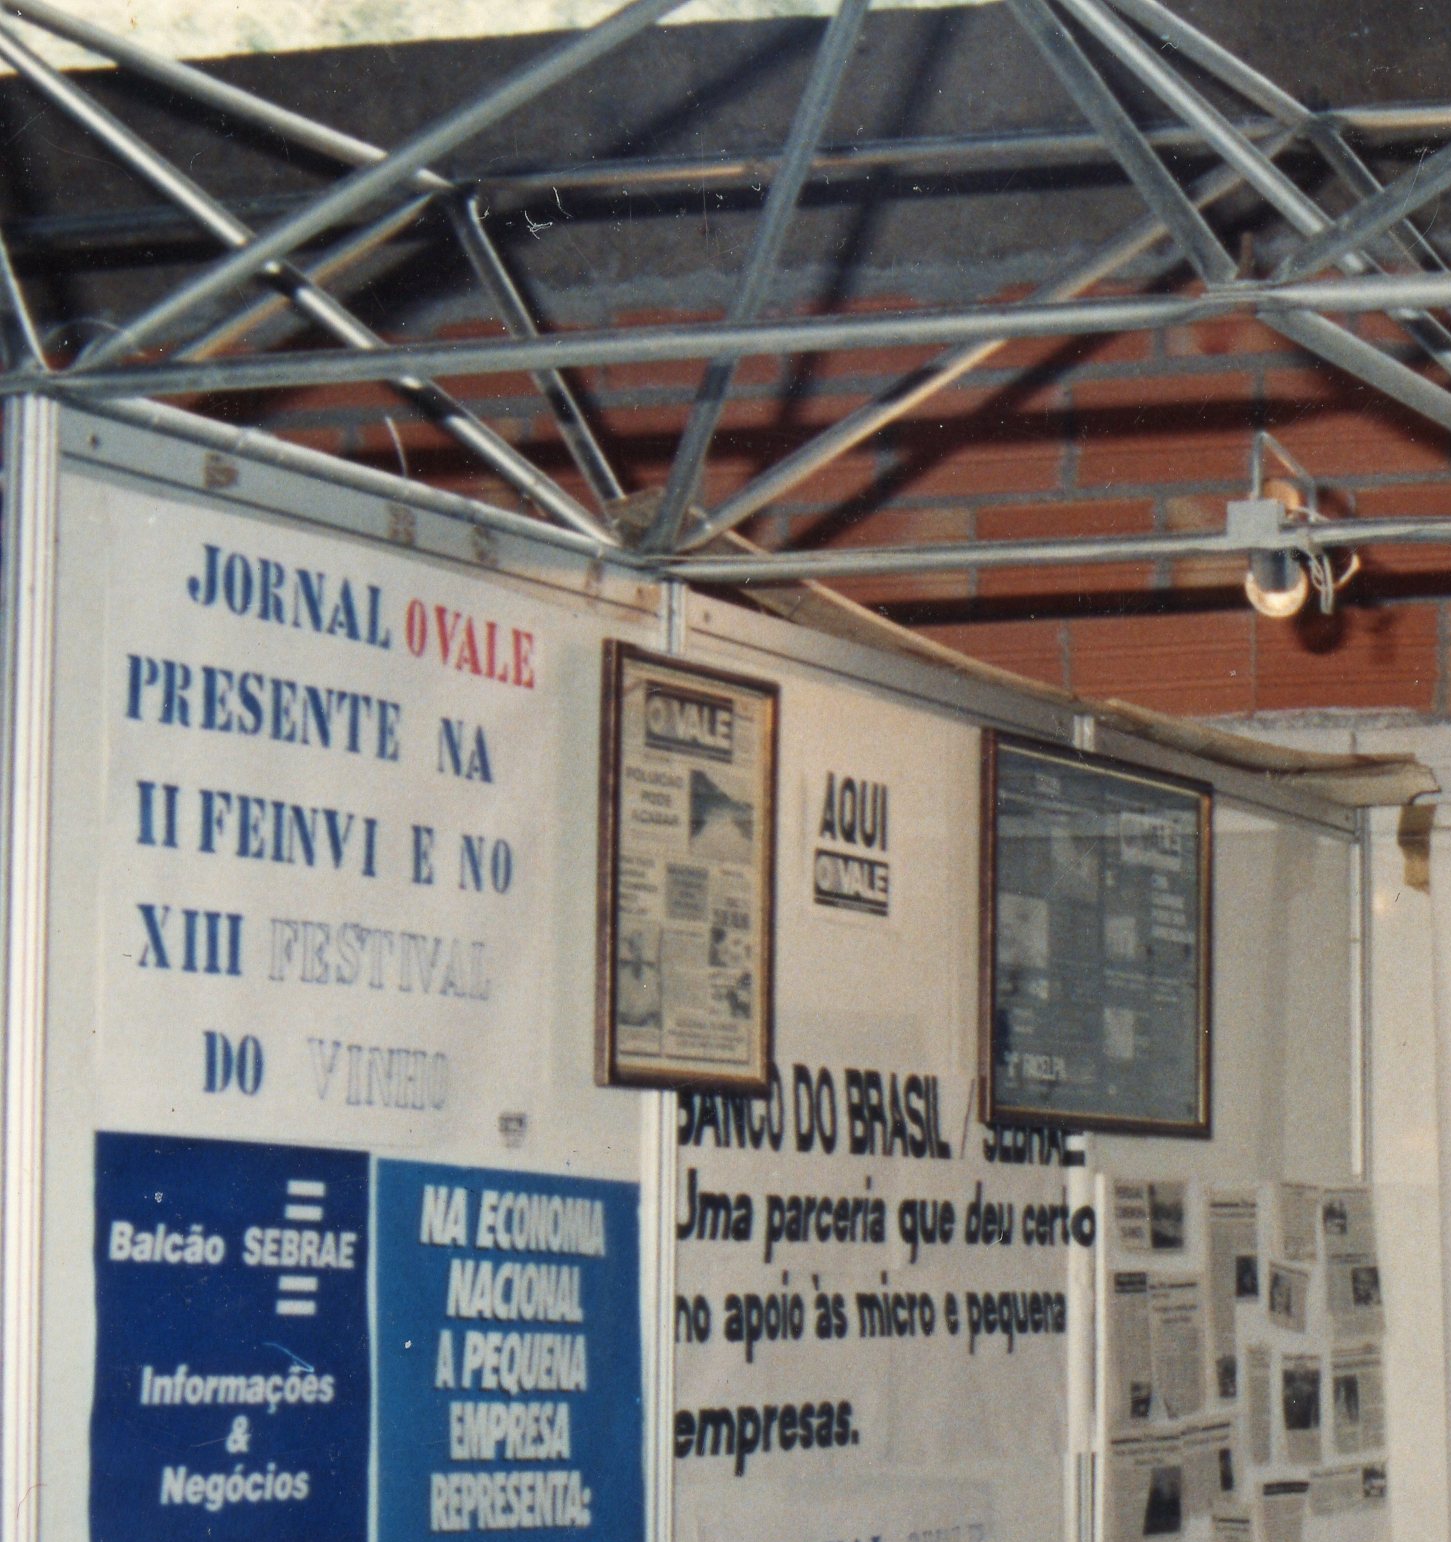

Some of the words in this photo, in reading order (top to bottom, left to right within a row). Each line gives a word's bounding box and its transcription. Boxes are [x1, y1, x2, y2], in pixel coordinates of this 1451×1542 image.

[187, 543, 391, 649] JORNAL
[125, 653, 401, 762] PRESENTE
[437, 716, 494, 783] NA
[136, 780, 180, 848] II
[410, 824, 434, 885] E
[459, 834, 513, 895] NO
[819, 770, 887, 851] AQUI
[136, 904, 243, 977] XIII
[268, 918, 491, 1001] FESTIVAL
[202, 1030, 264, 1096] DO
[793, 1063, 838, 1155] DO
[844, 1067, 952, 1160] BRASIL
[108, 1220, 225, 1266] Balcão
[242, 1226, 357, 1270] SEBRAE
[420, 1184, 468, 1246] NA
[475, 1190, 607, 1257] ECONOMIA
[766, 1175, 886, 1264] parceria
[900, 1197, 956, 1264] que
[965, 1180, 1014, 1245] deu
[1022, 1184, 1098, 1248] certo
[446, 1259, 584, 1324] NACIONAL
[724, 1269, 805, 1364] apoio
[855, 1269, 936, 1339] micro
[945, 1290, 960, 1336] e
[141, 1364, 335, 1415] Informações
[435, 1329, 455, 1391] A
[461, 1329, 588, 1395] PEQUENA
[225, 1414, 251, 1454] &
[449, 1401, 572, 1461] EMPRESA
[160, 1462, 309, 1512] Negócios
